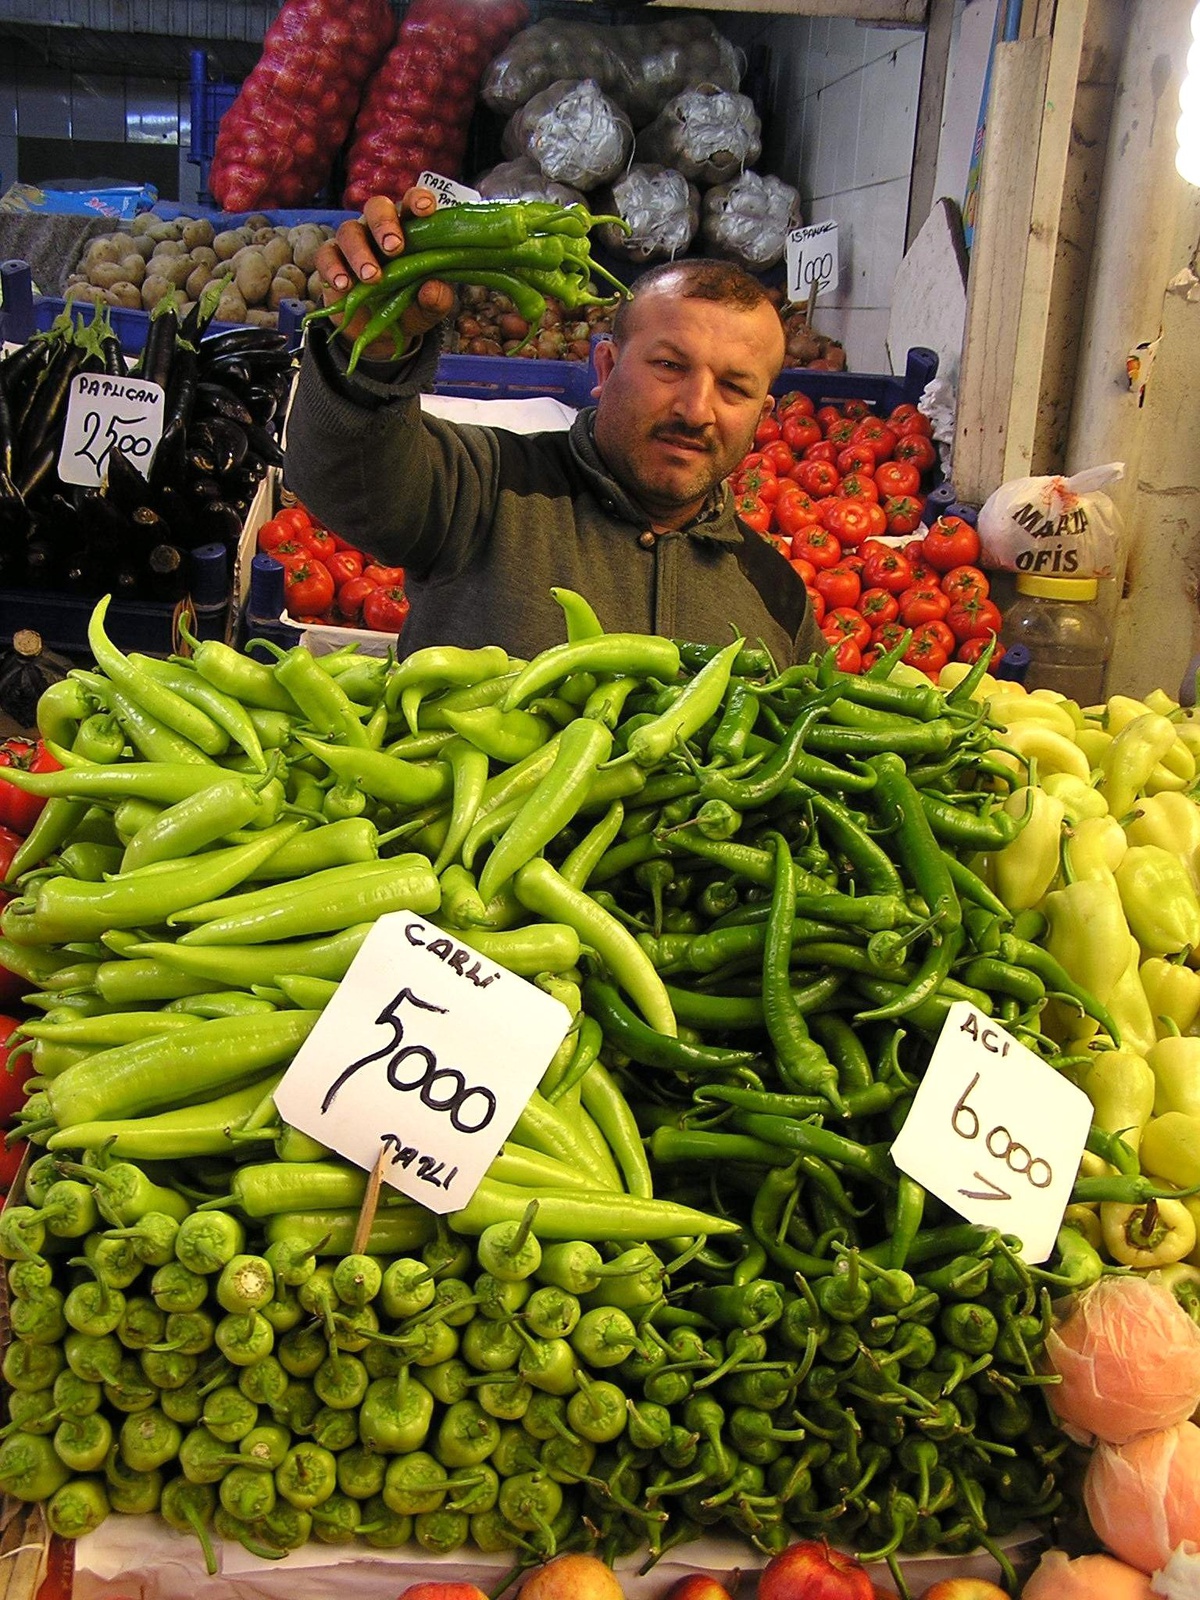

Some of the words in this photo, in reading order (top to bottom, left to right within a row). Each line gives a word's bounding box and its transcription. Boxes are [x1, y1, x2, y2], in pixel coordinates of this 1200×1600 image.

[794, 250, 833, 292] 1000
[74, 411, 152, 478] 2500
[320, 987, 497, 1133] 5000
[960, 1012, 1010, 1058] ACI
[951, 1071, 1052, 1189] 6000
